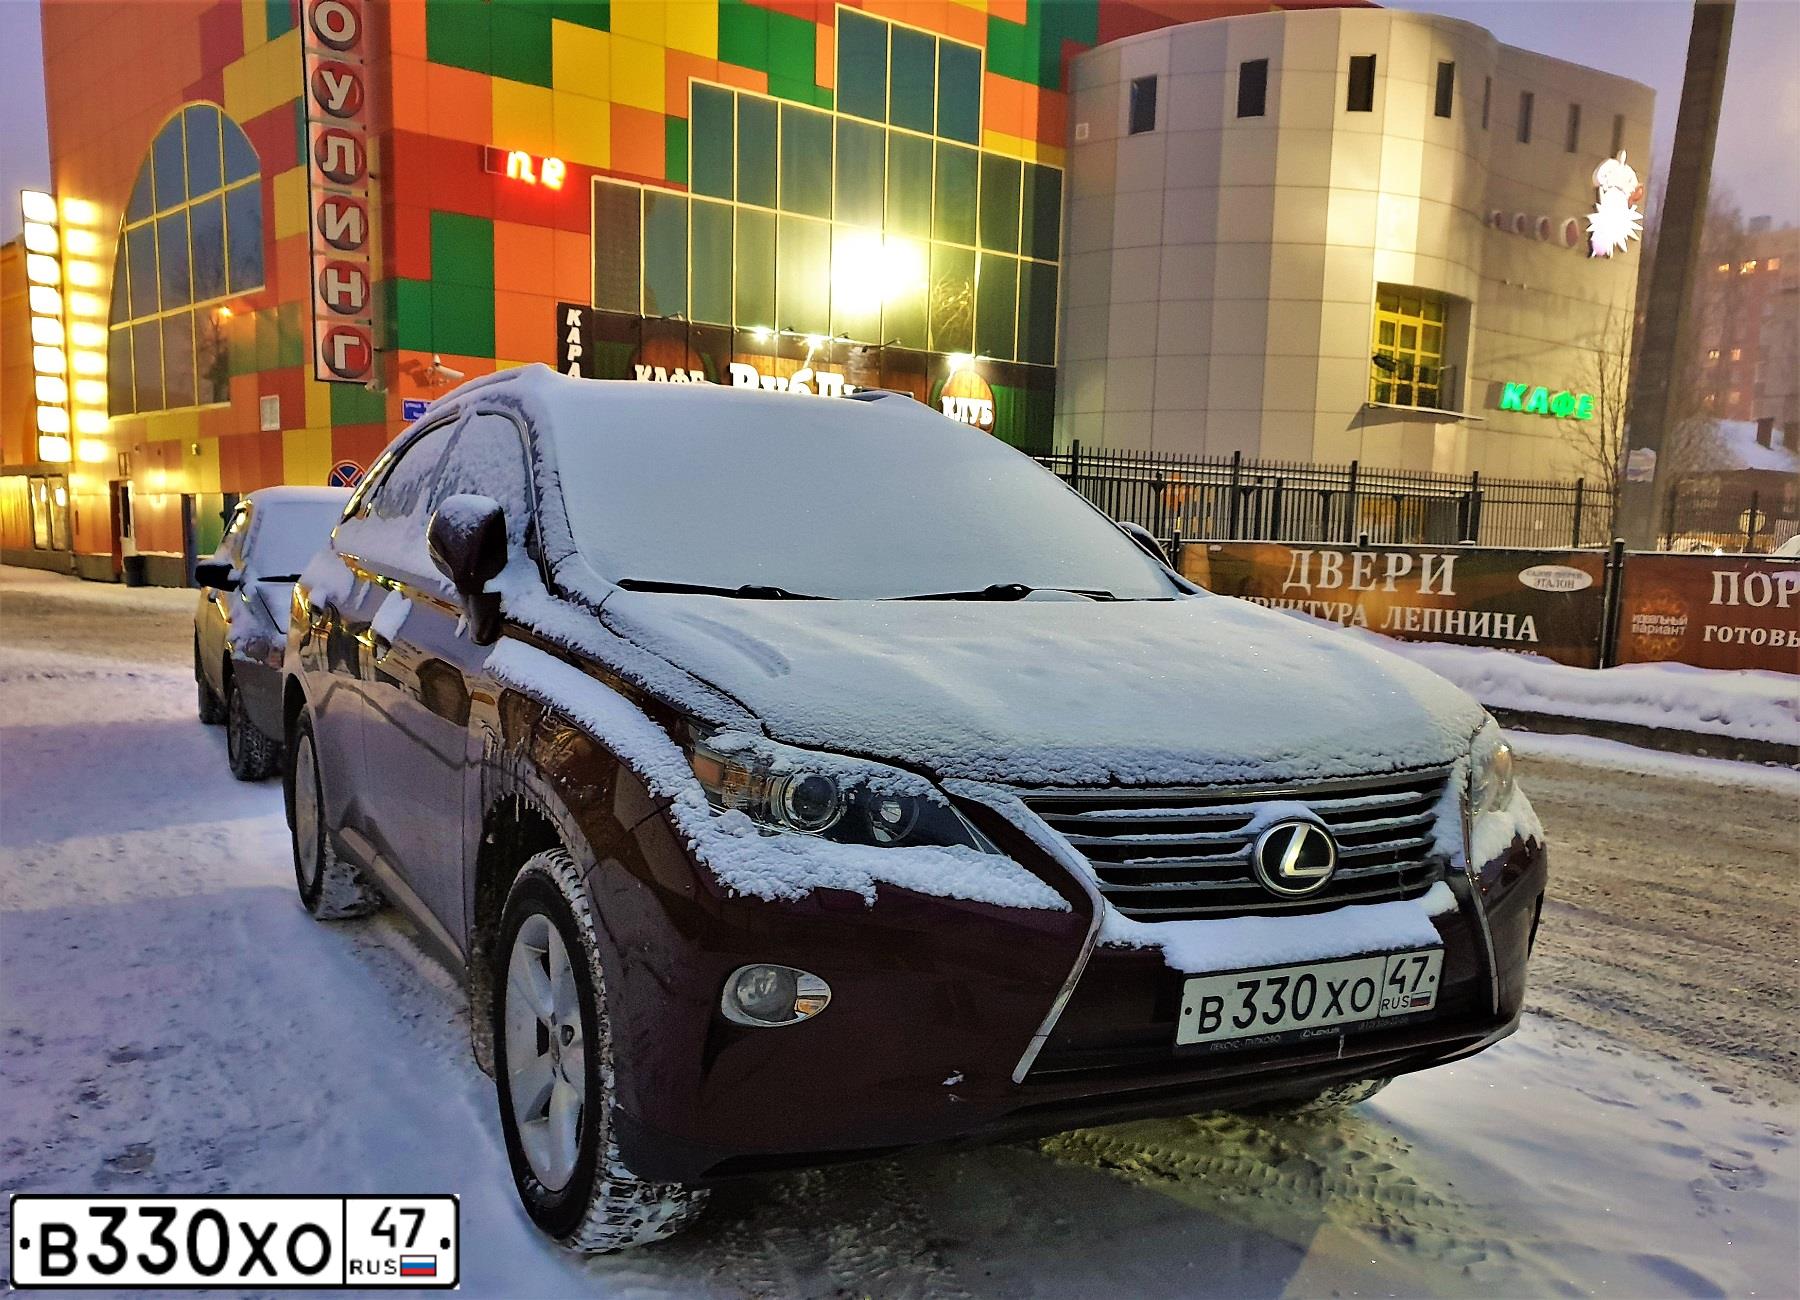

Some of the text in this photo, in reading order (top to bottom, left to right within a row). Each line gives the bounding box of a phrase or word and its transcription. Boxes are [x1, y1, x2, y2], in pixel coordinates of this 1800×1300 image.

[941, 396, 993, 425] КЛУБ
[1500, 381, 1595, 421] КАФЕ
[1282, 549, 1459, 597] ДВЕРИ
[1380, 605, 1540, 643] ЛЕПНИНА
[1198, 955, 1429, 1034] В330ХО 47
[1382, 995, 1409, 1011] RUS
